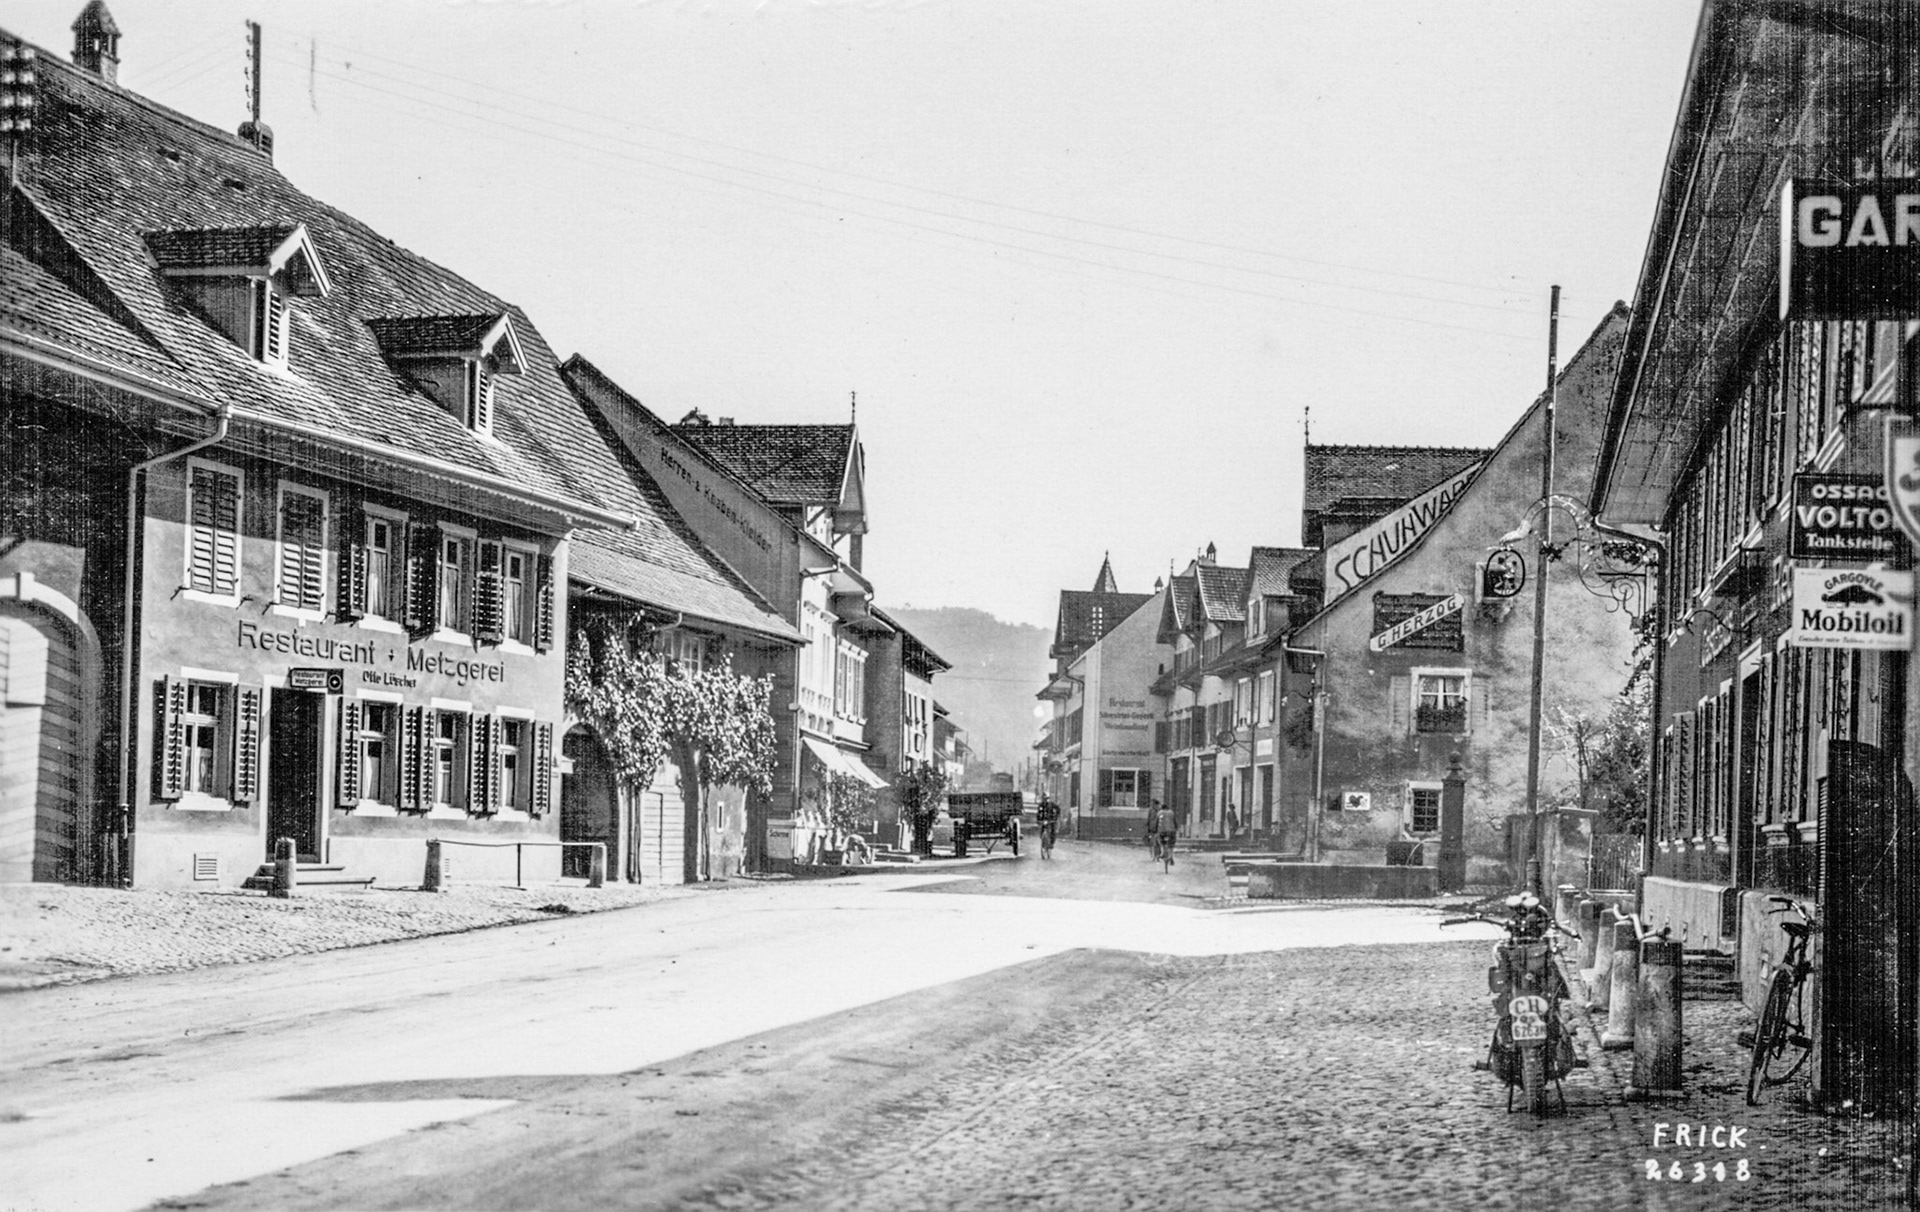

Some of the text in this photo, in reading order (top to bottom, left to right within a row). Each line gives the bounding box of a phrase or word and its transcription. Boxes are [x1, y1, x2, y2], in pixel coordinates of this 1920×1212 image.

[1806, 532, 1894, 551] Tankstelle
[1824, 572, 1884, 591] GARGOYLE
[1392, 597, 1456, 641] HERZOG
[1801, 608, 1904, 635] Mobiloil
[238, 619, 505, 687] Restaurant Metzgerei
